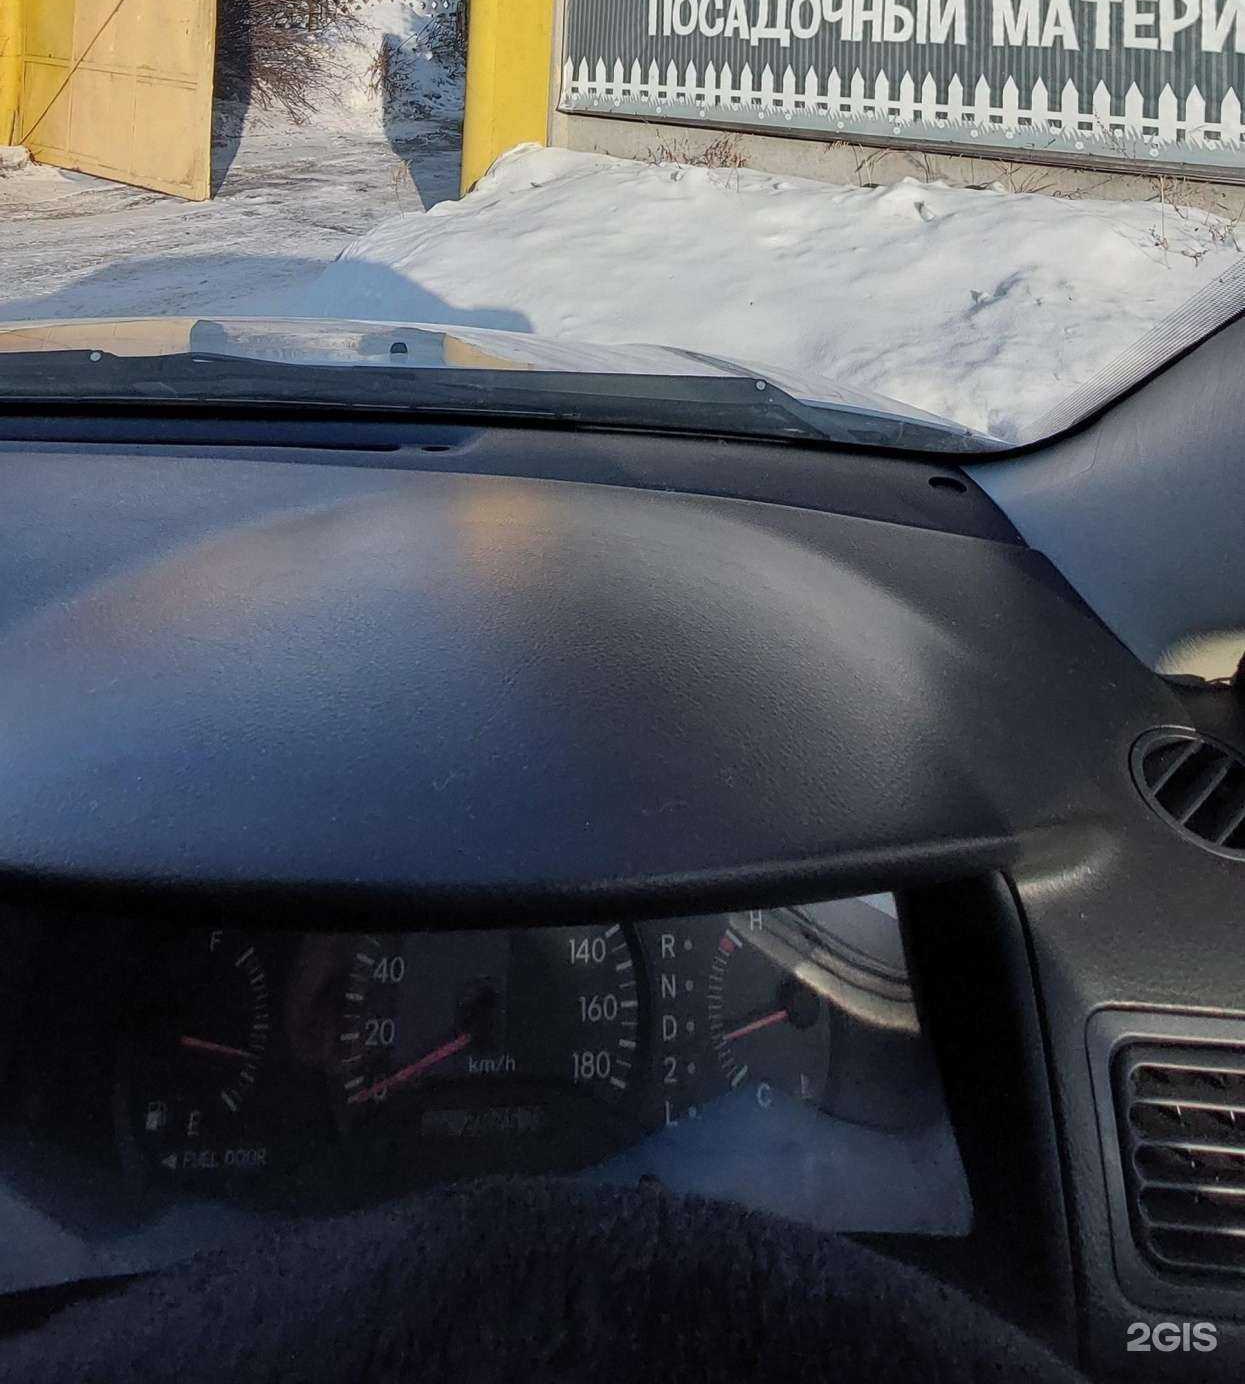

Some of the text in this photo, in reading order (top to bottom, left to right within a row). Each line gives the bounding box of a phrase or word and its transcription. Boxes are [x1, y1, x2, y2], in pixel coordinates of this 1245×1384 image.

[569, 937, 607, 965] 140
[661, 934, 676, 959] R
[373, 956, 405, 984] 40
[661, 973, 677, 999] N
[578, 993, 618, 1022] 160
[365, 1018, 395, 1046] 20
[662, 1015, 678, 1041] D
[469, 1055, 517, 1073] km/h
[572, 1050, 610, 1084] 180
[664, 1056, 678, 1084] 2
[756, 1082, 773, 1109] C
[664, 1100, 679, 1127] L
